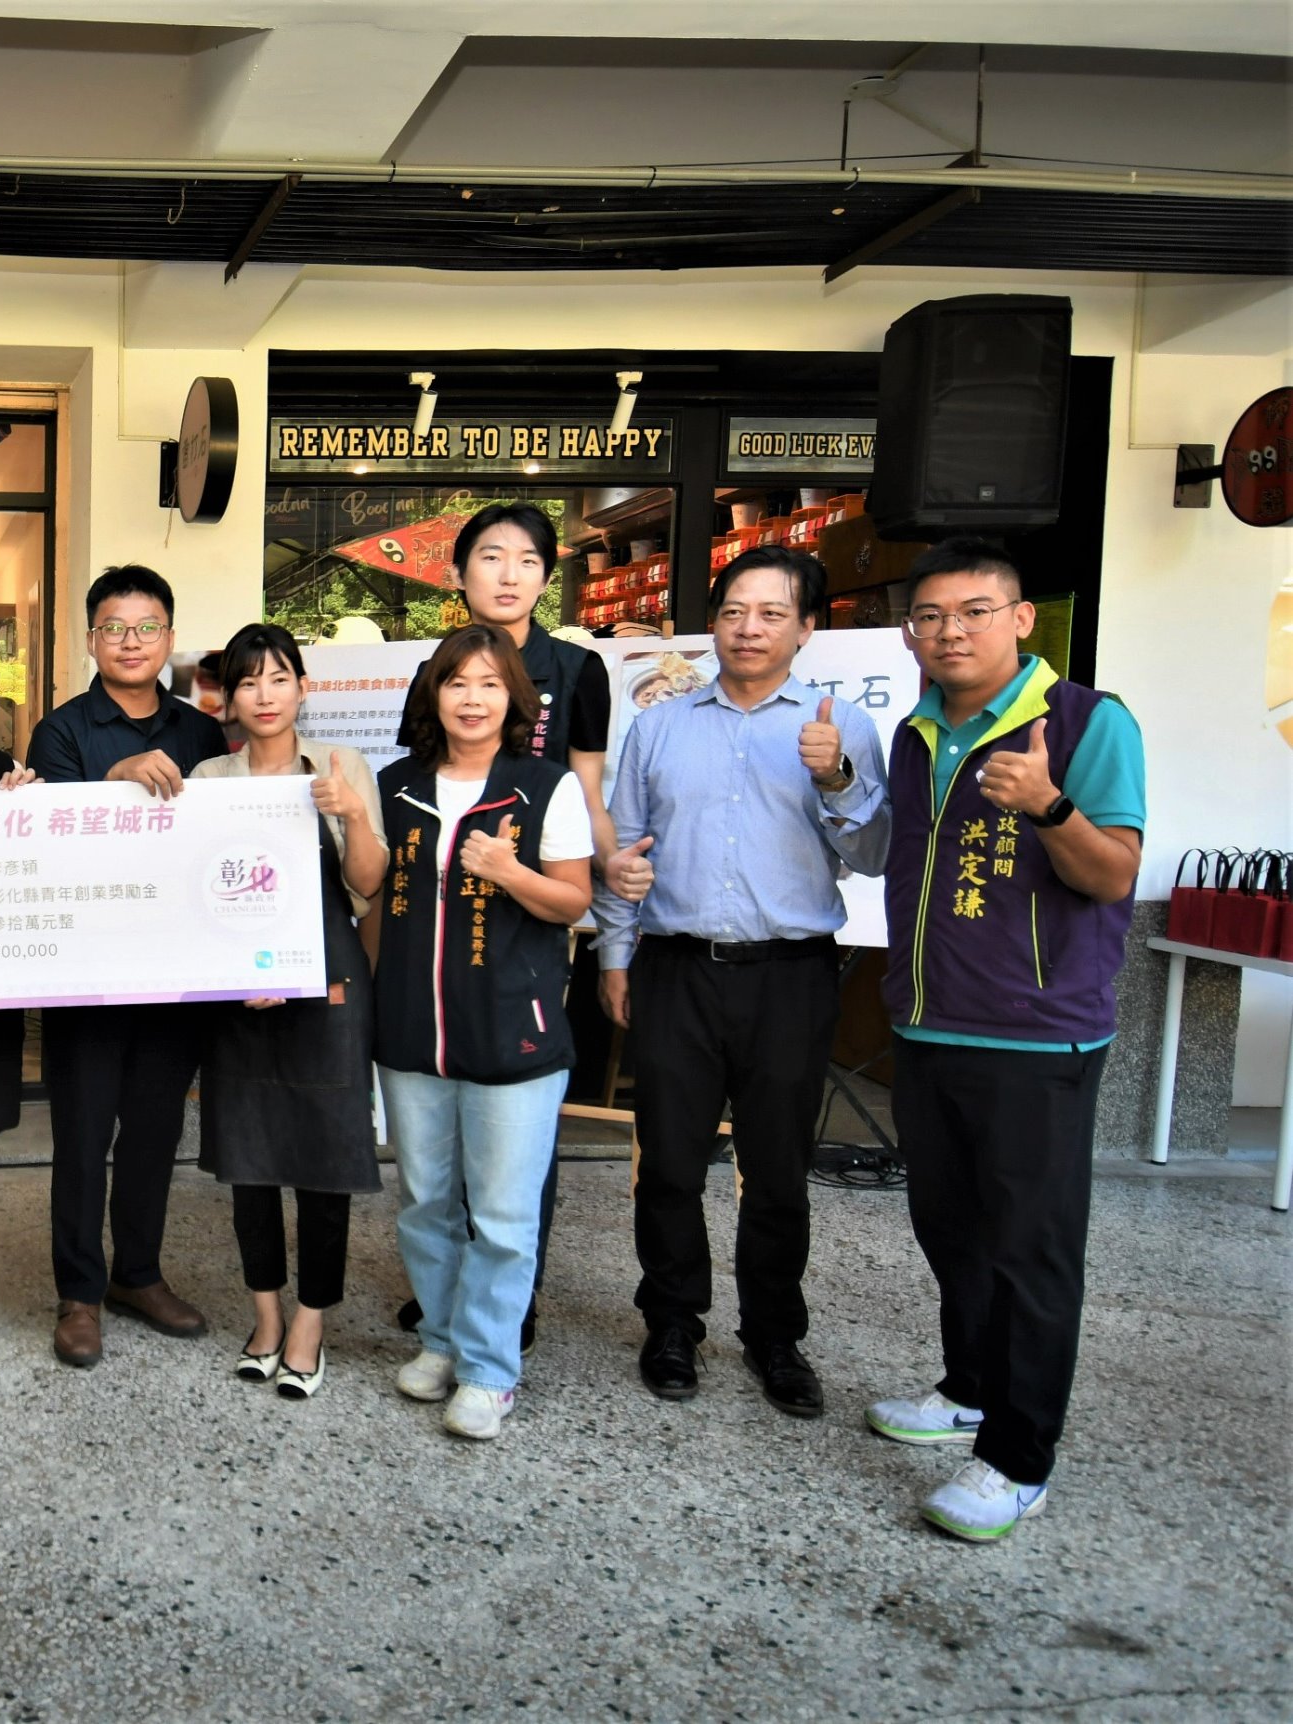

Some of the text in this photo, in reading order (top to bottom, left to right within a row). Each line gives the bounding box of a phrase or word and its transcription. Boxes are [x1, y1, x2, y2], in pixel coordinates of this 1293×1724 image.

[279, 427, 662, 458] REMEMBER TO BE HAPPY
[740, 434, 786, 456] GOOD
[791, 434, 841, 456] LUCK
[47, 803, 176, 837] 希望城市
[992, 808, 1022, 878] 政顧問
[219, 855, 280, 893] 彰化
[952, 817, 989, 919] 洪定謙
